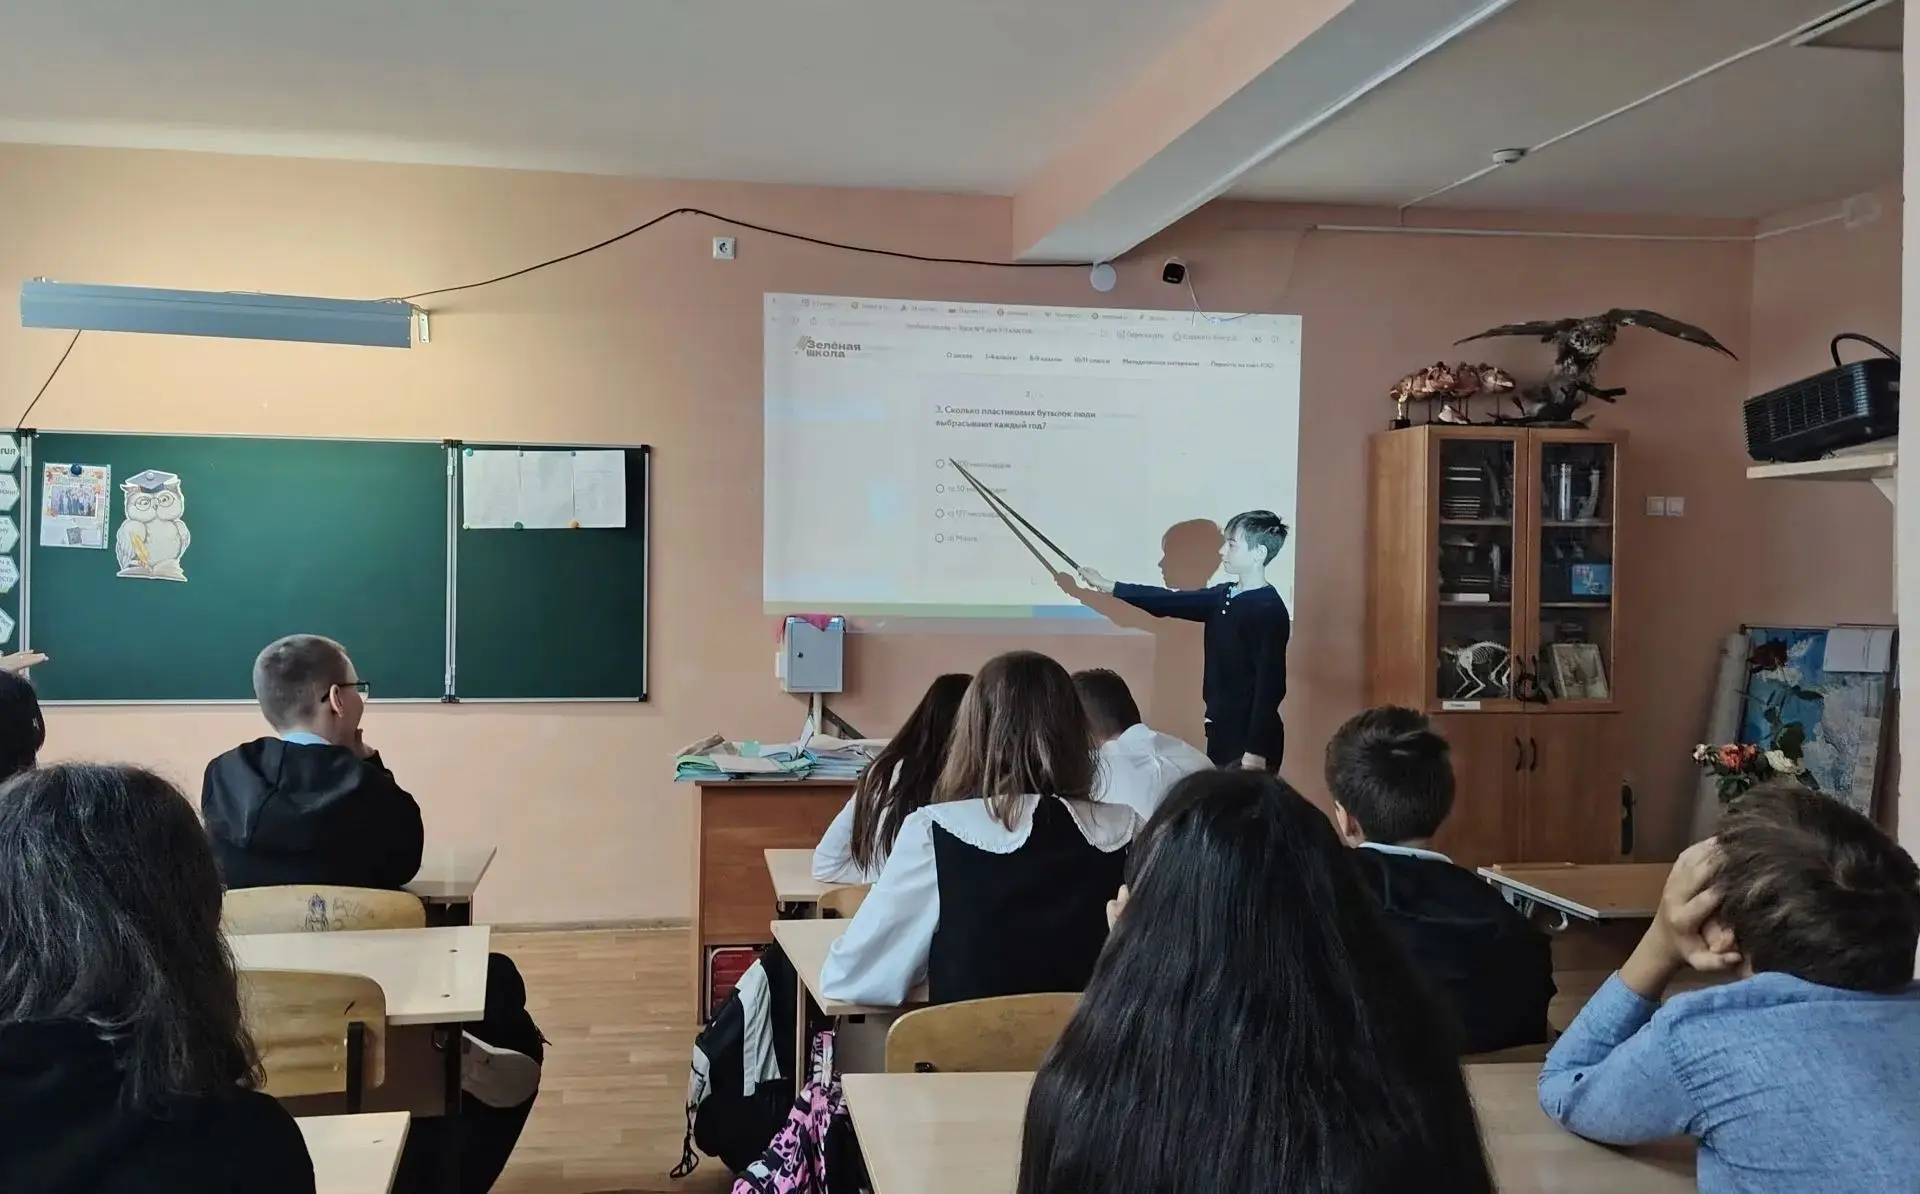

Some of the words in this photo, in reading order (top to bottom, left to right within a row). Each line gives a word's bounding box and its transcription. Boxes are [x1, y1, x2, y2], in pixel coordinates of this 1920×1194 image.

[807, 340, 861, 351] Зелёная
[806, 349, 846, 358] школа
[944, 405, 980, 415] Сколько
[981, 408, 1036, 417] пластиковых
[1037, 409, 1071, 419] бутылок
[1073, 411, 1096, 419] люди
[936, 419, 992, 429] выбрасывают
[994, 420, 1027, 430] каждый
[1028, 422, 1047, 430] год?
